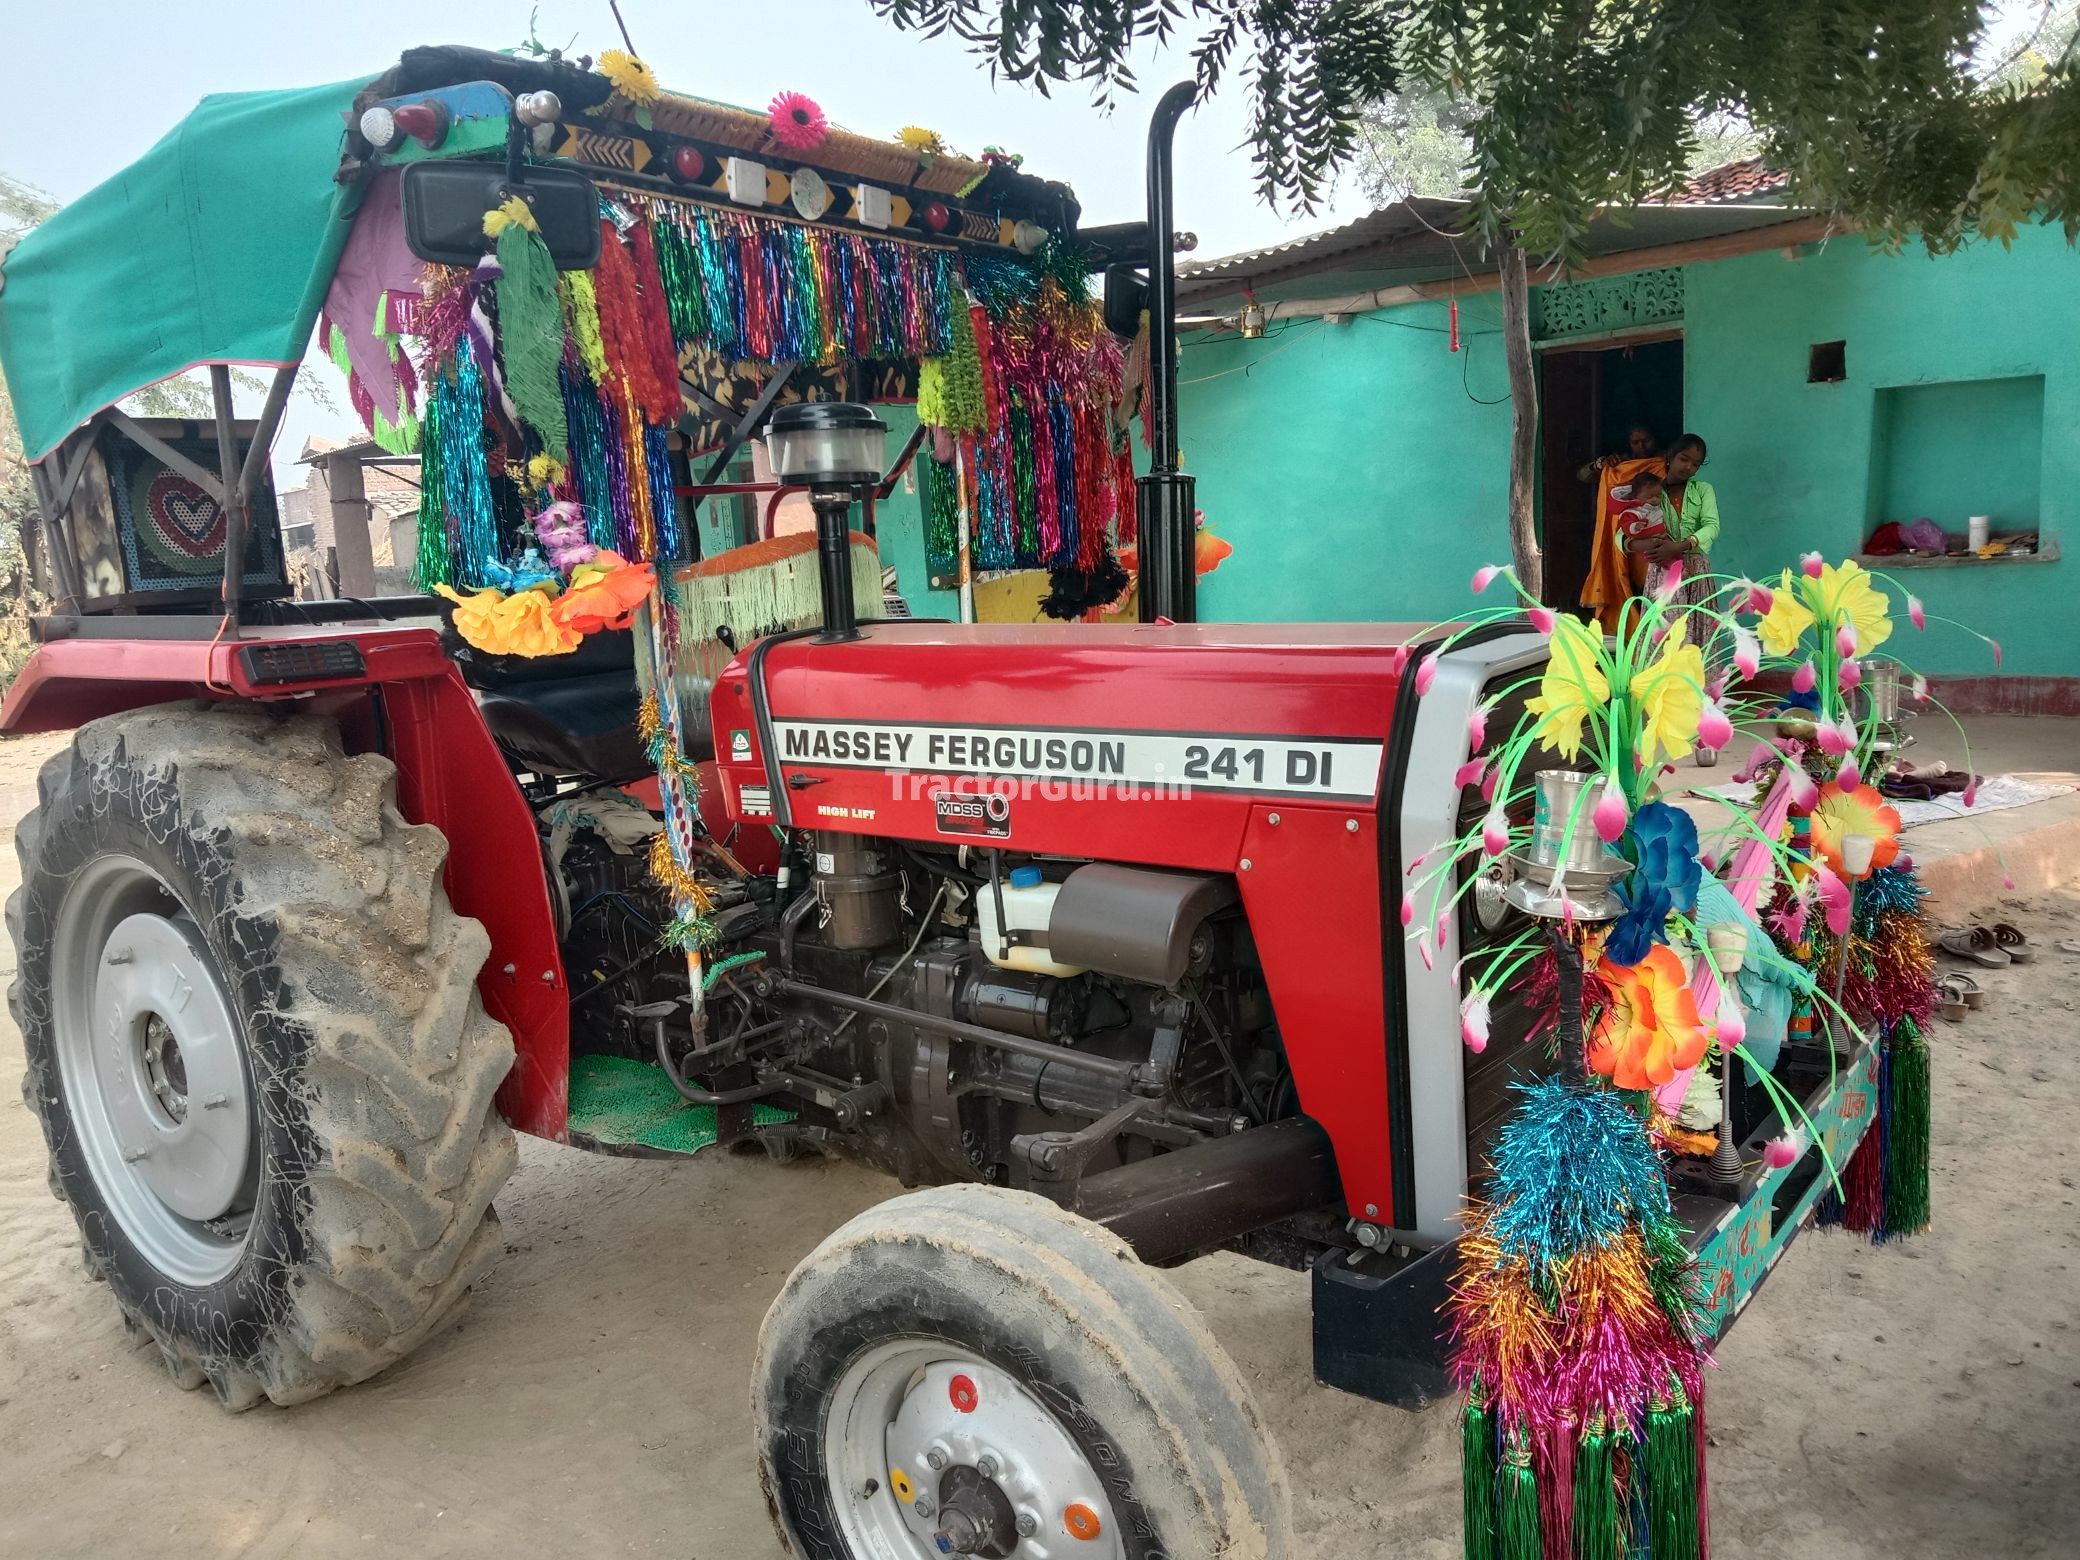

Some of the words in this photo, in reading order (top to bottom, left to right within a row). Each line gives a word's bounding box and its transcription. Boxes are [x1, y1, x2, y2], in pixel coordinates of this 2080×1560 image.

[786, 729, 913, 763] MASSEY
[928, 734, 1125, 774] FERGUSON
[1184, 745, 1265, 783] 241
[1286, 750, 1332, 787] DI
[817, 805, 849, 817] HIGH
[851, 807, 876, 820] LIFT
[937, 801, 983, 818] MDSS
